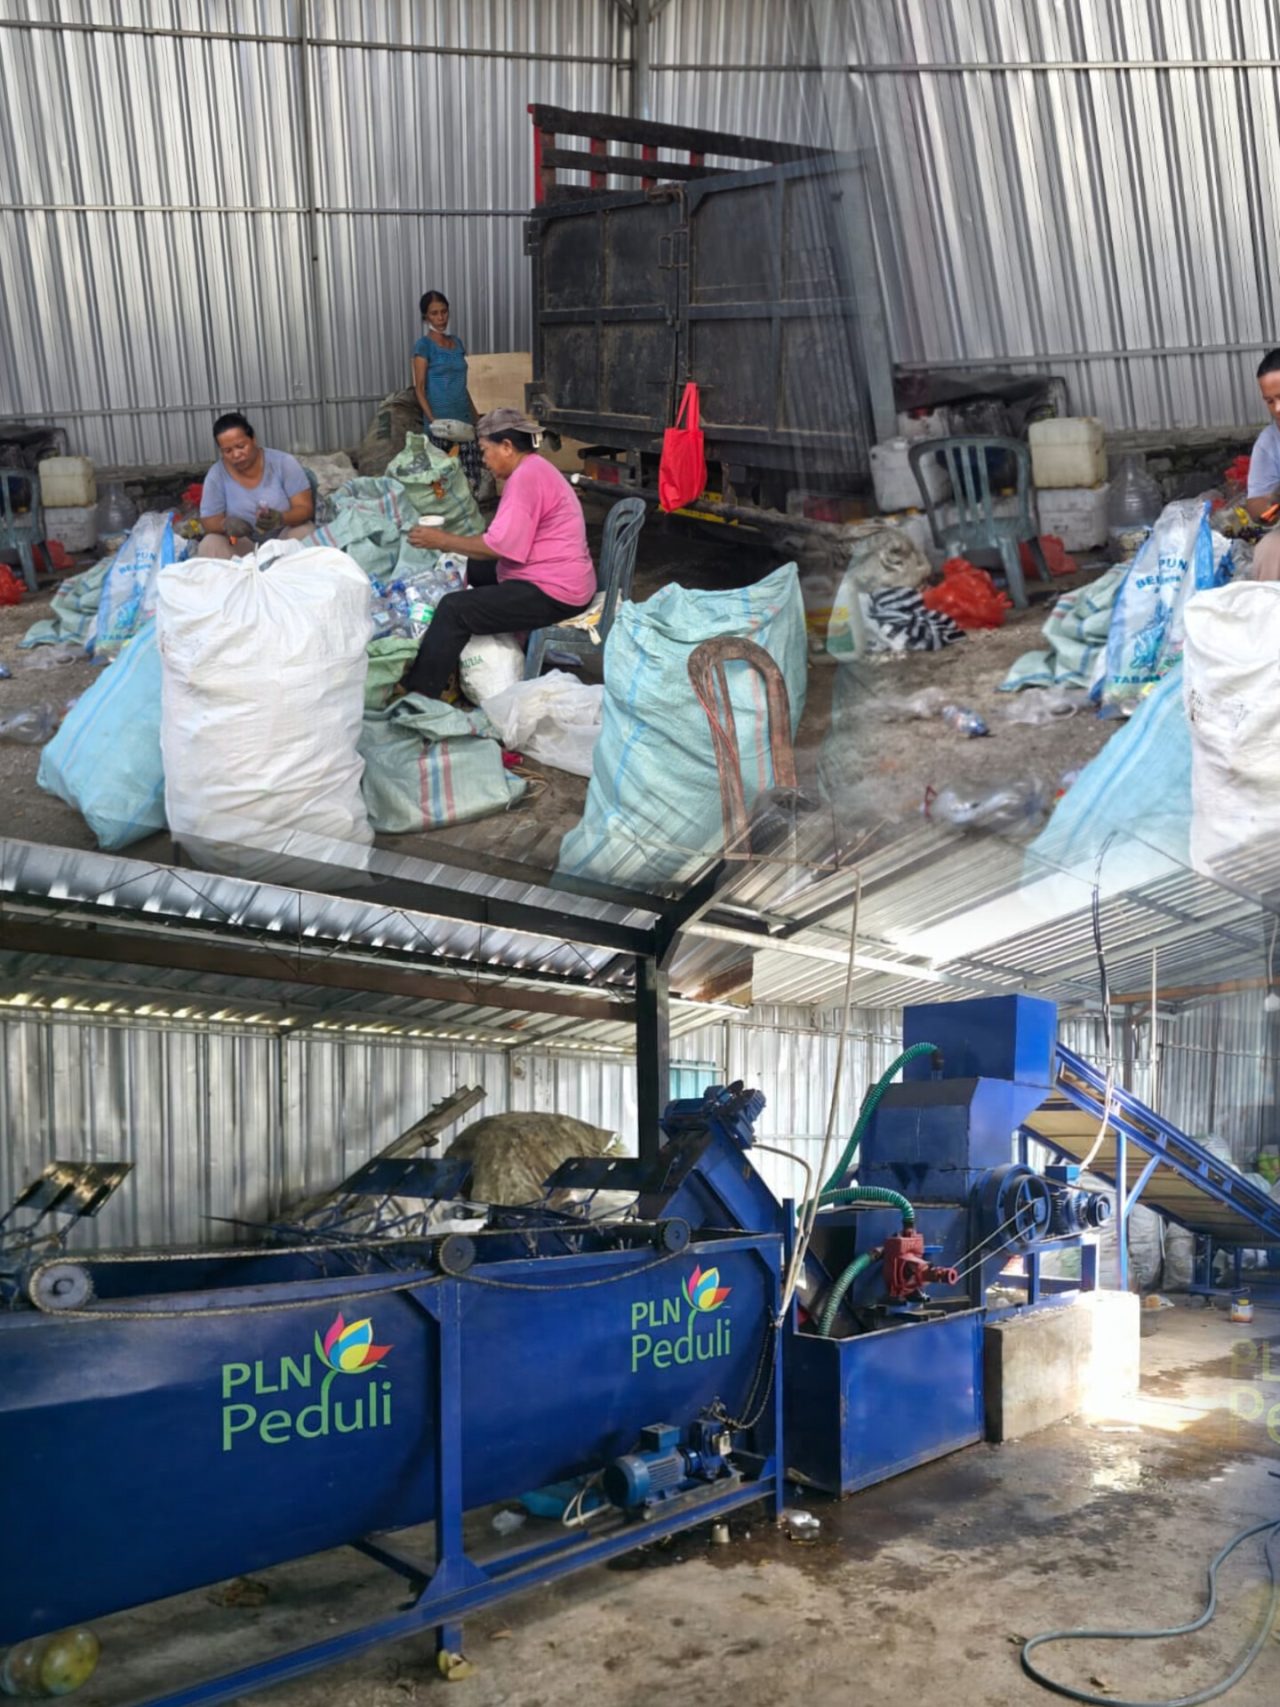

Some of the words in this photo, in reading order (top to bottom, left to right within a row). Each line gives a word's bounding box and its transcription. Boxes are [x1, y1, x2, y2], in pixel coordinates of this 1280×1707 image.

[632, 1297, 680, 1330] PLN
[632, 1318, 730, 1373] Peduli
[222, 1354, 311, 1399] PLN
[222, 1380, 392, 1451] Peduli
